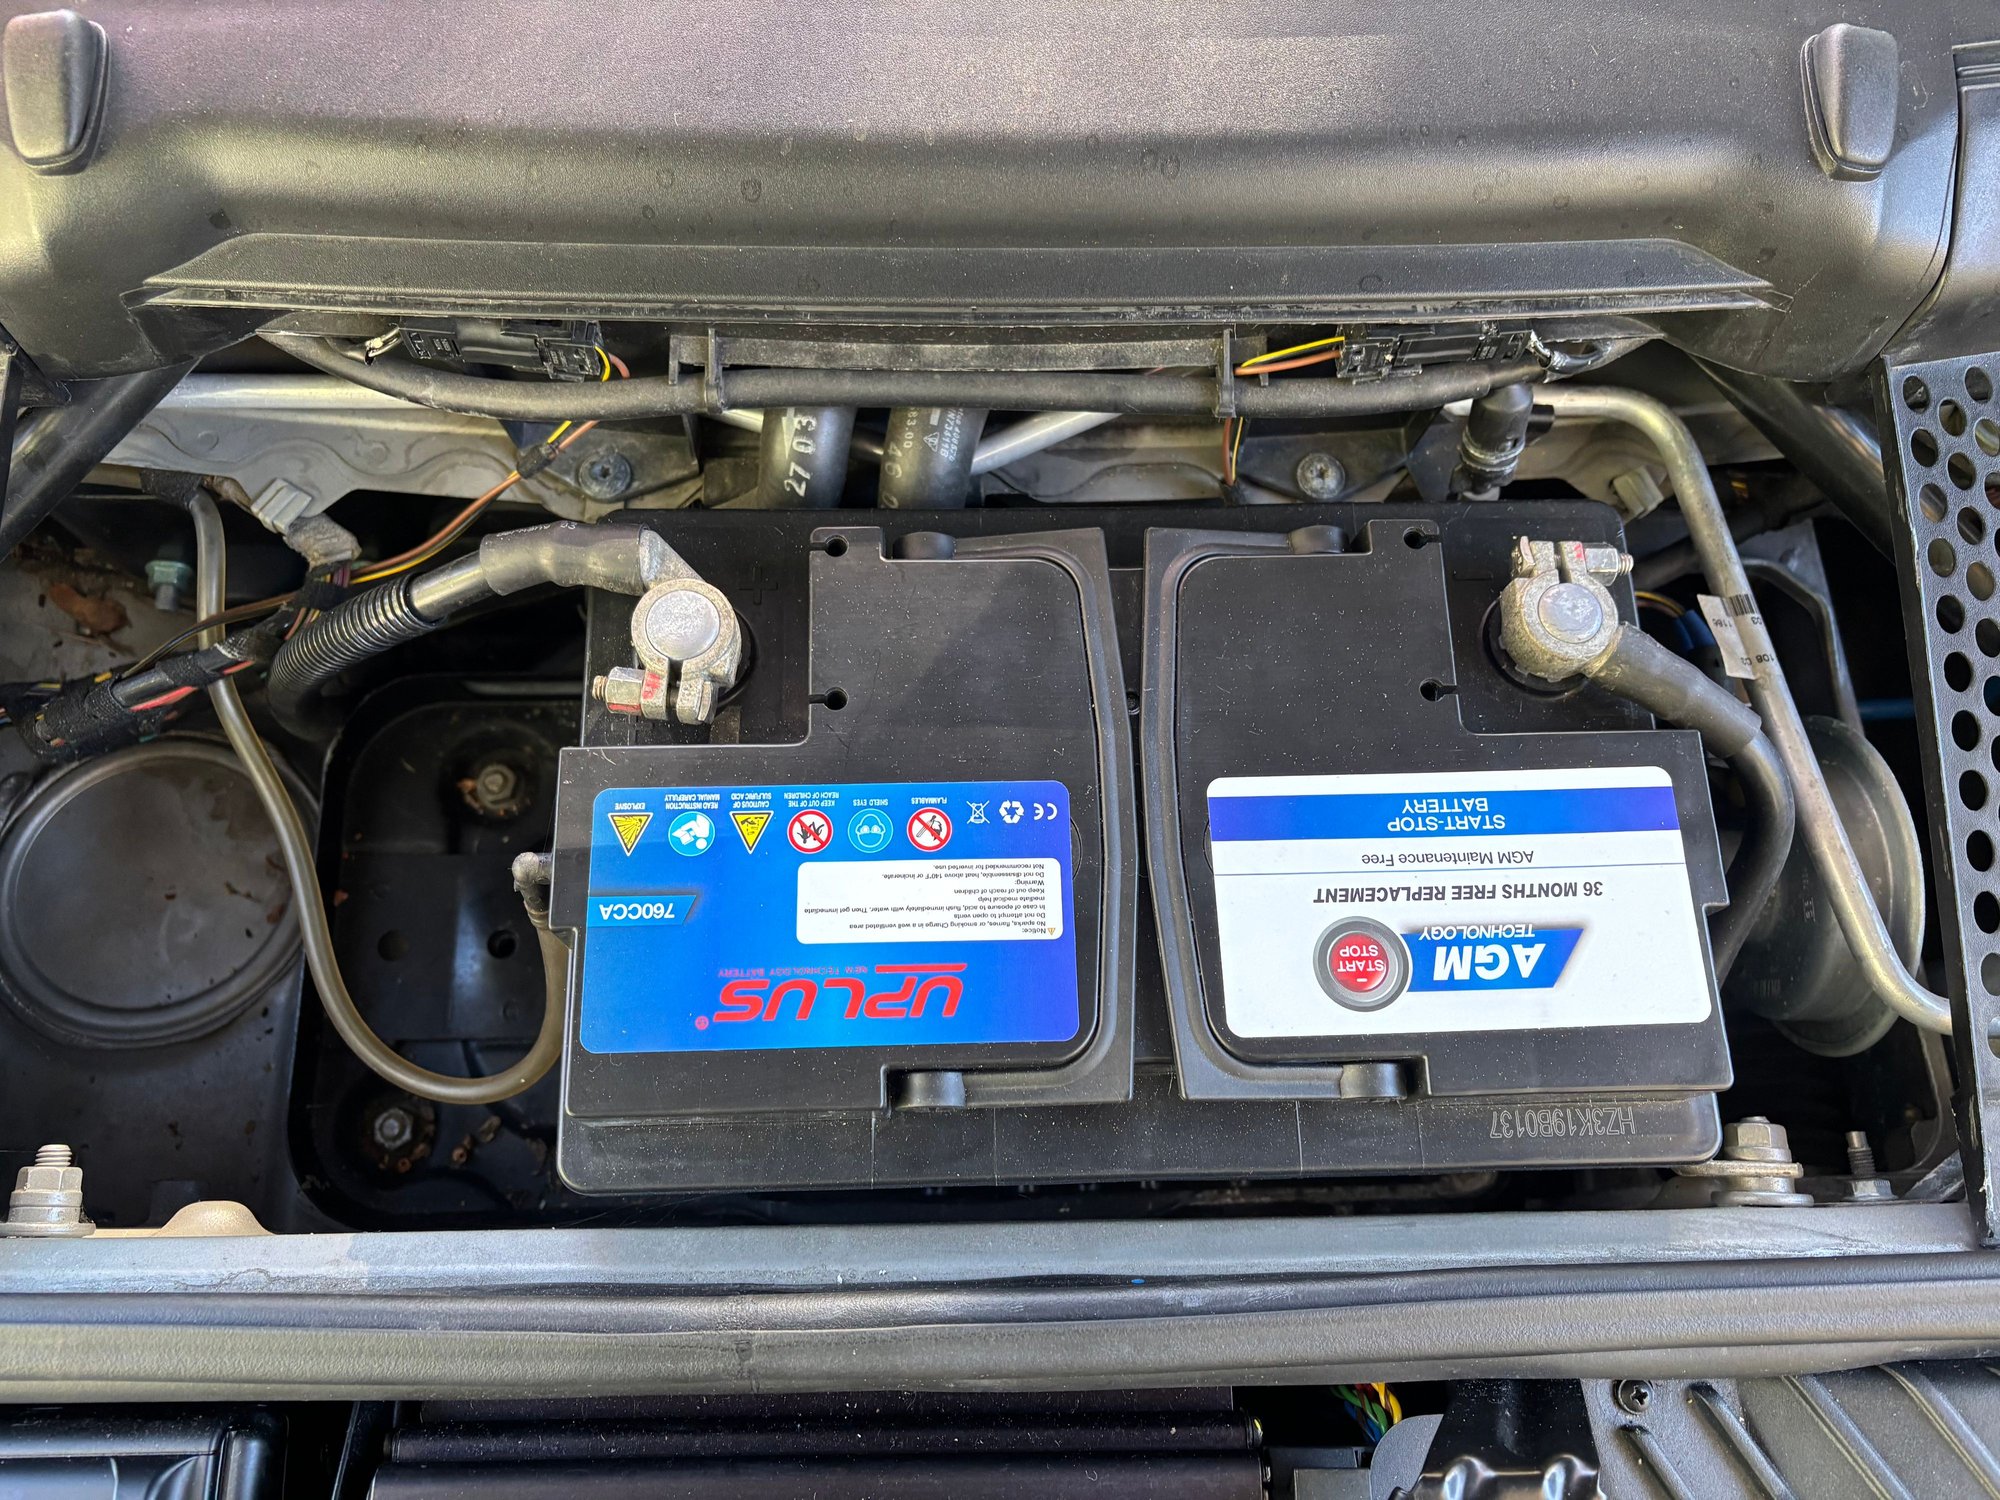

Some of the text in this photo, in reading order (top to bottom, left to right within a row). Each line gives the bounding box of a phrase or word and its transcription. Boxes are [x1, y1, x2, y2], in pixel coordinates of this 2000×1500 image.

[784, 461, 811, 498] 27
[744, 792, 772, 800] SULFURIC
[1401, 797, 1488, 814] BATTERY
[1387, 815, 1506, 832] START-STOP
[1361, 850, 1534, 867] AGM Maintenance Free
[1313, 881, 1603, 903] 36 MONTHS FREE REPLACEMENT
[599, 903, 675, 921] 760CCA
[1418, 923, 1536, 941] TECHNOLOGY
[1339, 945, 1378, 957] STOP
[1337, 959, 1385, 972] START
[1433, 942, 1546, 981] AGM
[718, 968, 764, 977] BATTERY
[770, 966, 839, 975] TECHNOLOGY
[713, 975, 963, 1022] UPLUS
[1489, 1106, 1636, 1139] HZ3K19B0137
